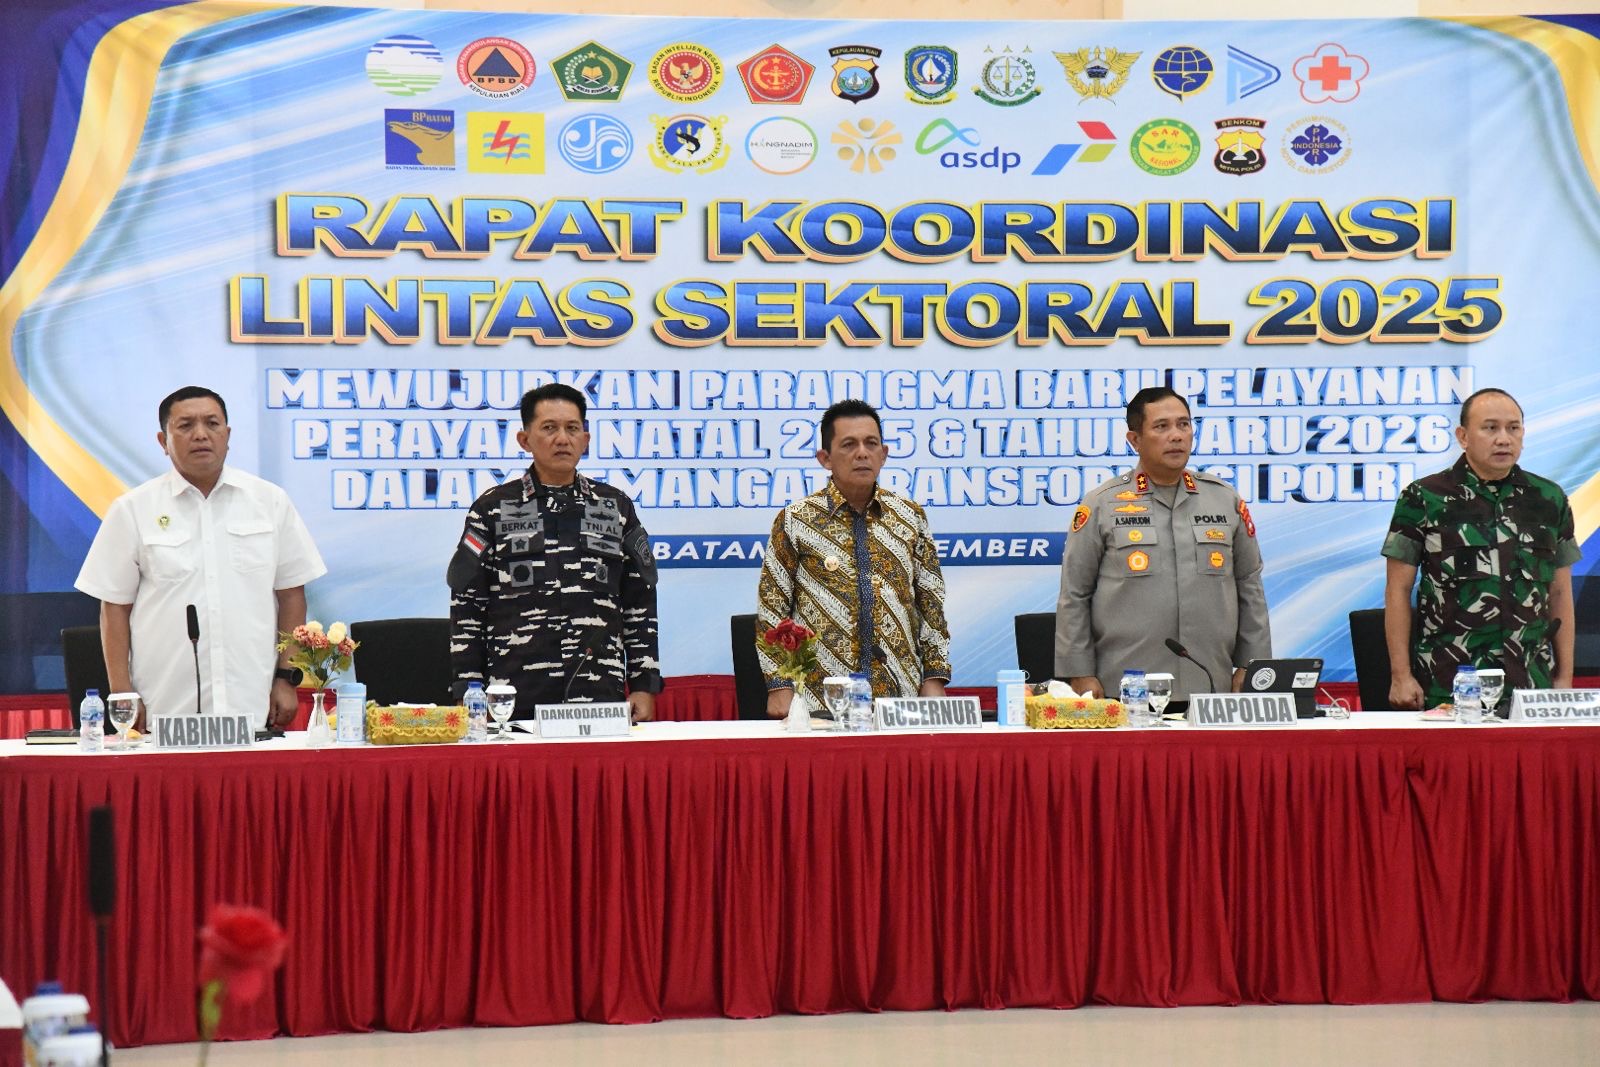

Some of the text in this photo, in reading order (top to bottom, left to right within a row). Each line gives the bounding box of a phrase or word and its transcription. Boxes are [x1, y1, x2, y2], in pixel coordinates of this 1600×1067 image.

[651, 44, 721, 75] BADAN INTELIJEN NEGARA
[831, 47, 879, 56] KEPULAUAN RIAU
[469, 84, 526, 99] KEPULAUAN RIAU
[652, 78, 720, 102] REPUBLIK INDONESIA
[1151, 127, 1180, 138] SAR
[1221, 119, 1260, 127] SENKOM
[940, 146, 1022, 174] asdp
[1219, 163, 1262, 172] MITRA POLRI
[276, 193, 1457, 264] RAPAT KOORDINASI
[229, 273, 1506, 348] LINTAS SEKTORAL 2025
[689, 369, 1006, 411] PARADIGMA
[1165, 365, 1476, 408] PELAYANAN
[293, 418, 589, 460] PERAYAA
[597, 418, 771, 460] NATAL
[780, 418, 917, 459] 25
[928, 417, 967, 459] &
[1189, 415, 1304, 457] ARU
[1305, 414, 1451, 455] 2026
[577, 467, 831, 509] MANGAT
[1257, 462, 1416, 504] POLRI
[501, 521, 539, 533] BERKAT
[585, 521, 619, 535] TNI AL
[1193, 514, 1228, 525] POLRI
[935, 538, 1051, 558] EMBER
[540, 706, 627, 721] DANKODAERAL
[881, 699, 978, 727] GUBERNUR
[1196, 697, 1294, 724] KAPOLDA
[157, 715, 251, 748] KABINDA
[578, 723, 592, 737] IV
